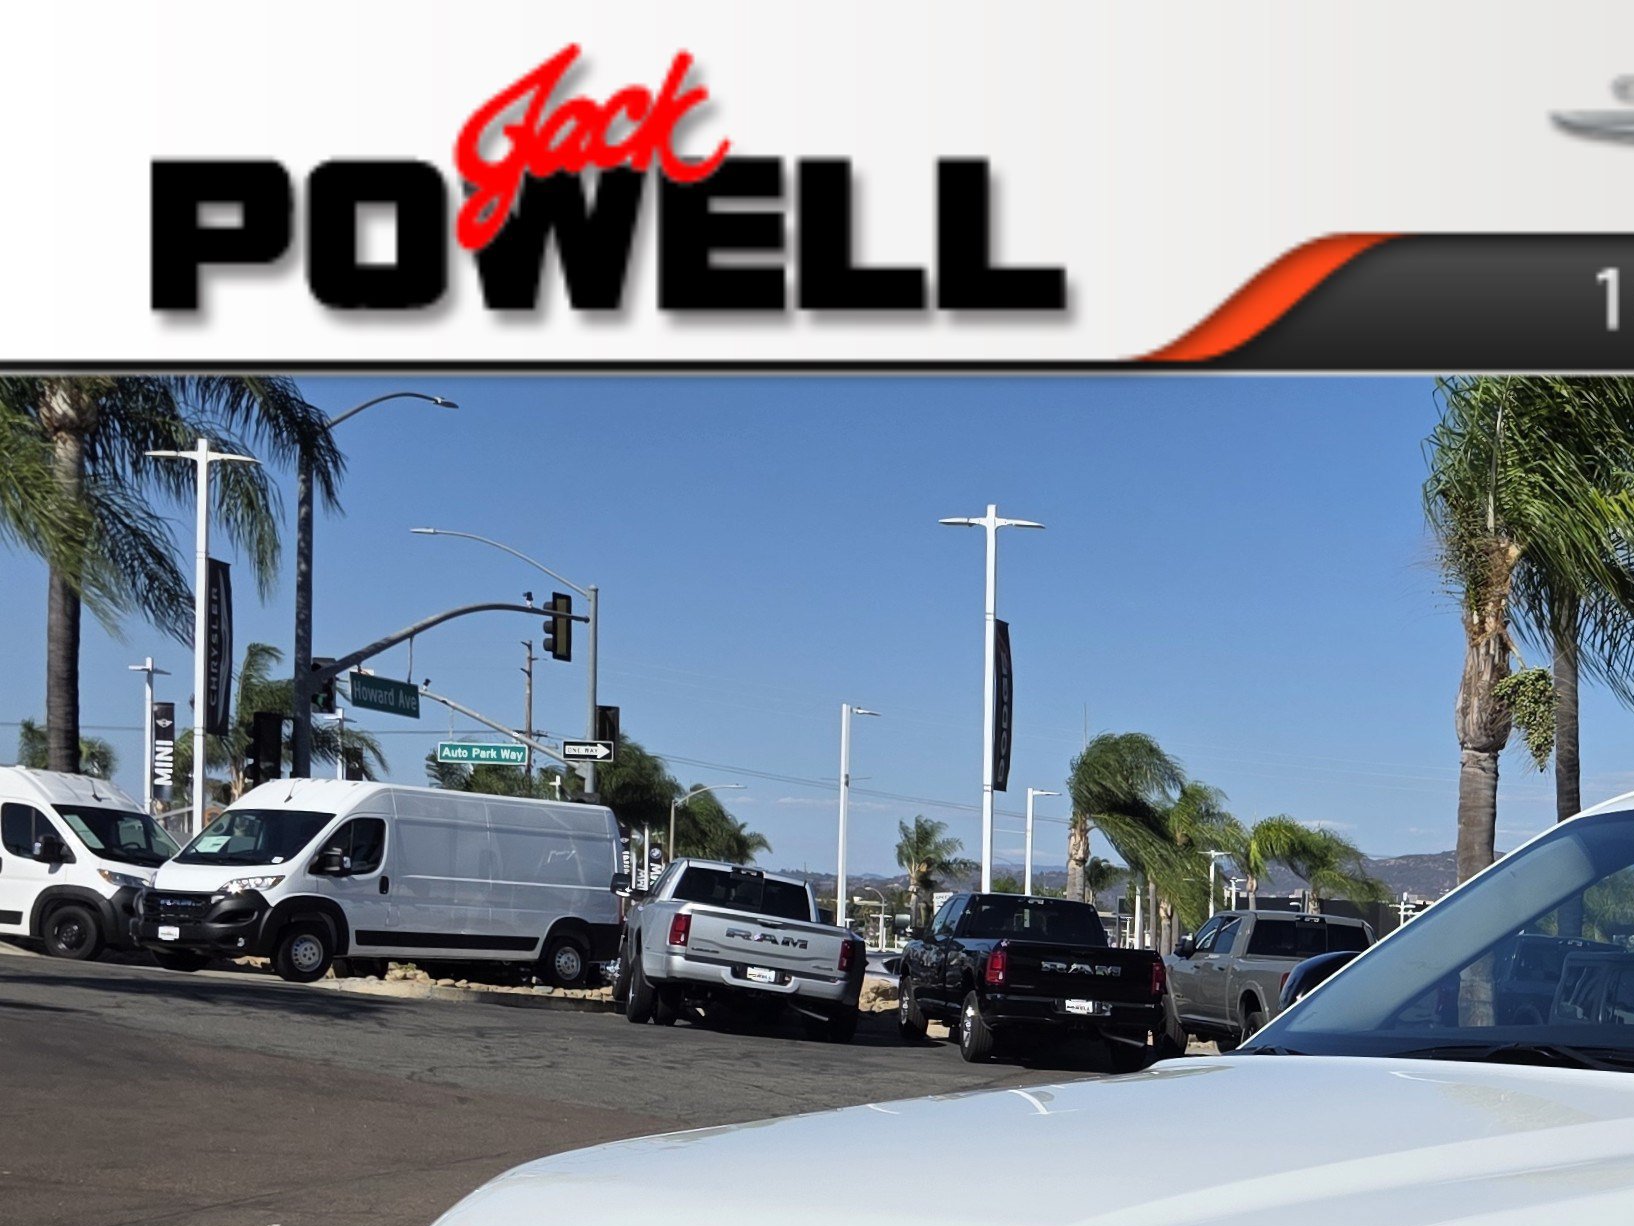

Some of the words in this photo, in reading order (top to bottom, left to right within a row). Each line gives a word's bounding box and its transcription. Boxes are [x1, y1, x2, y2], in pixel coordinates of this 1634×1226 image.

[209, 587, 219, 706] CHRYSLER
[353, 681, 394, 706] Howard
[398, 689, 417, 711] Ave
[154, 739, 173, 786] MINI
[442, 747, 468, 758] Auto
[472, 748, 497, 759] Park
[500, 749, 524, 762] Way
[725, 927, 808, 950] RAM
[1041, 961, 1122, 977] RAM
